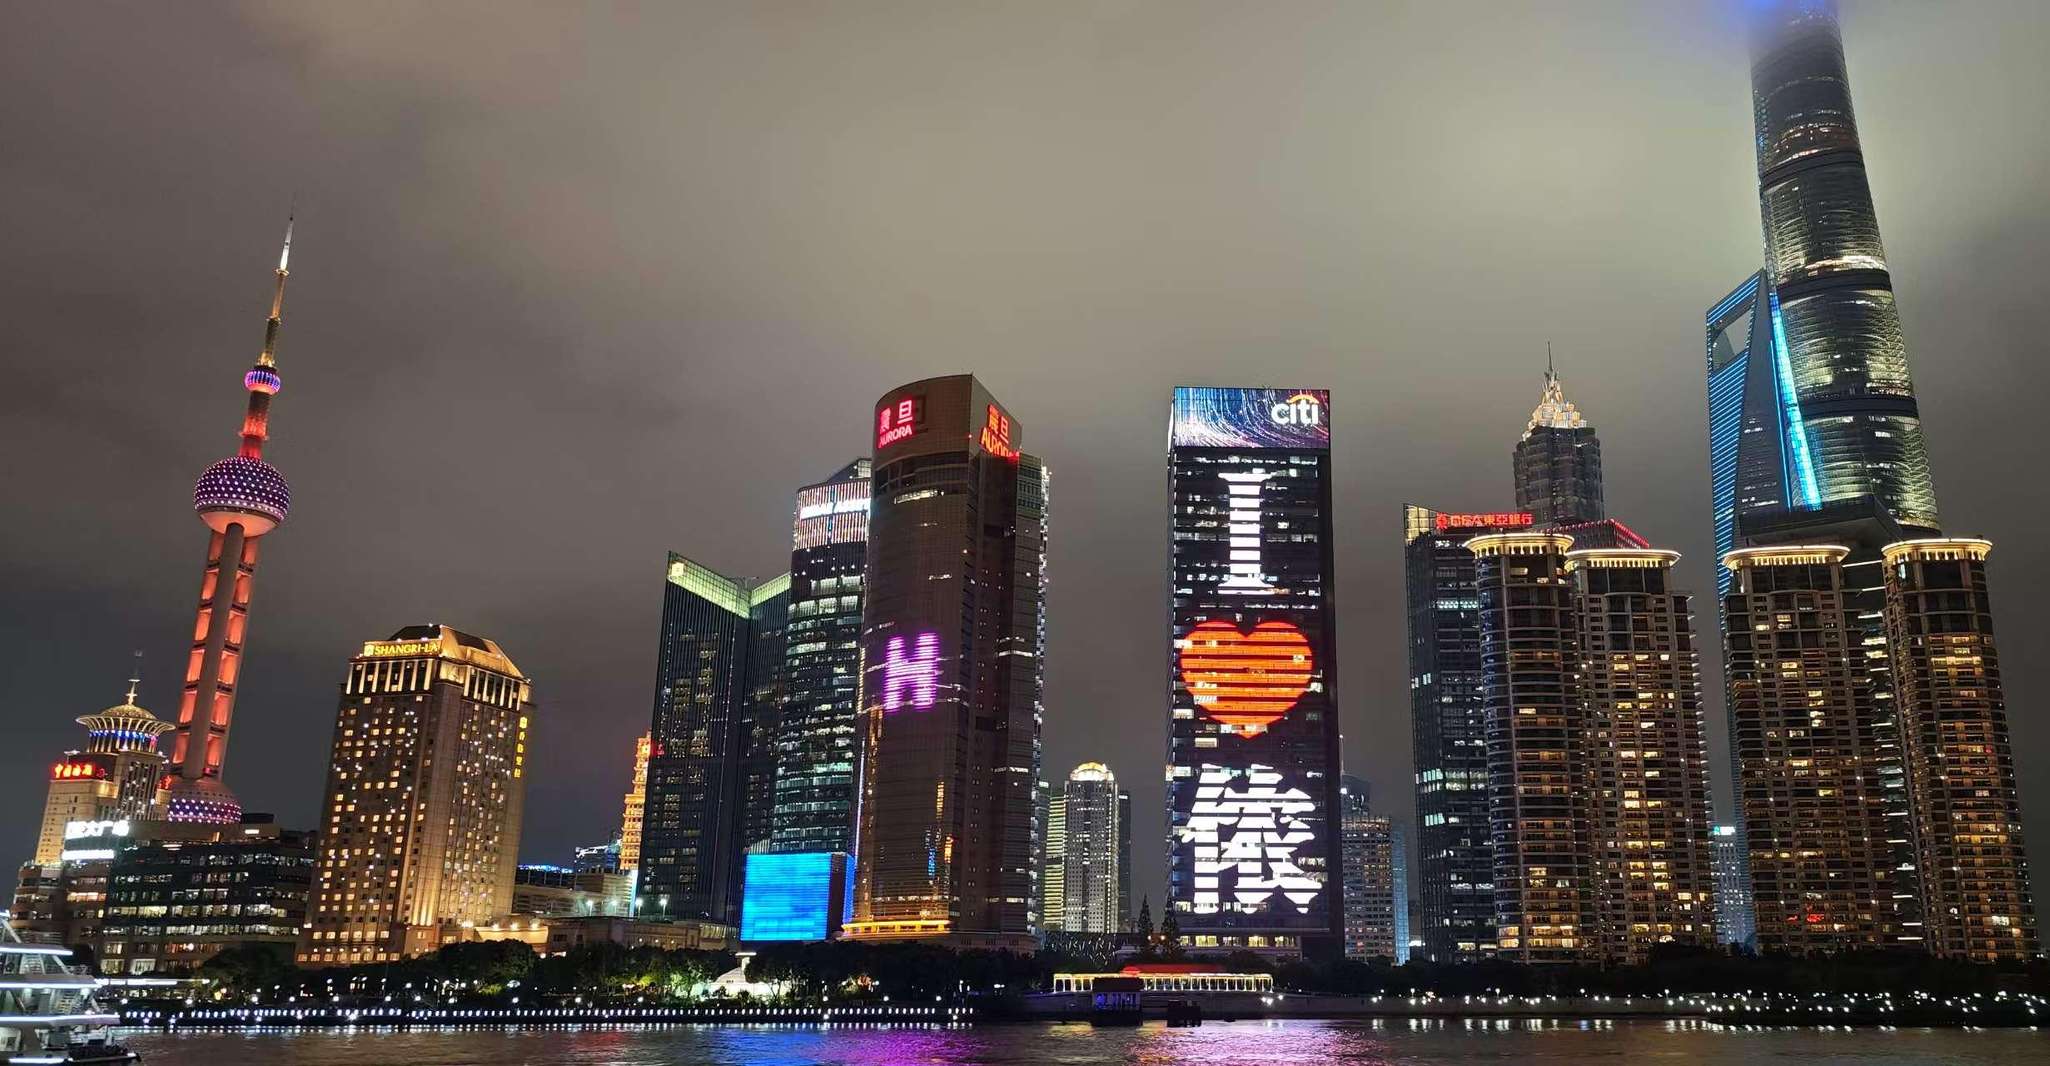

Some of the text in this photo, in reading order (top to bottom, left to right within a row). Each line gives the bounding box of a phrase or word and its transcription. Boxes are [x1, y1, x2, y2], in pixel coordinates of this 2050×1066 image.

[1271, 395, 1319, 425] citi
[878, 424, 912, 448] AURORA
[981, 427, 1019, 457] AUROR
[1217, 468, 1276, 595] I
[374, 643, 438, 656] SHANGRI-LA
[883, 632, 939, 712] H
